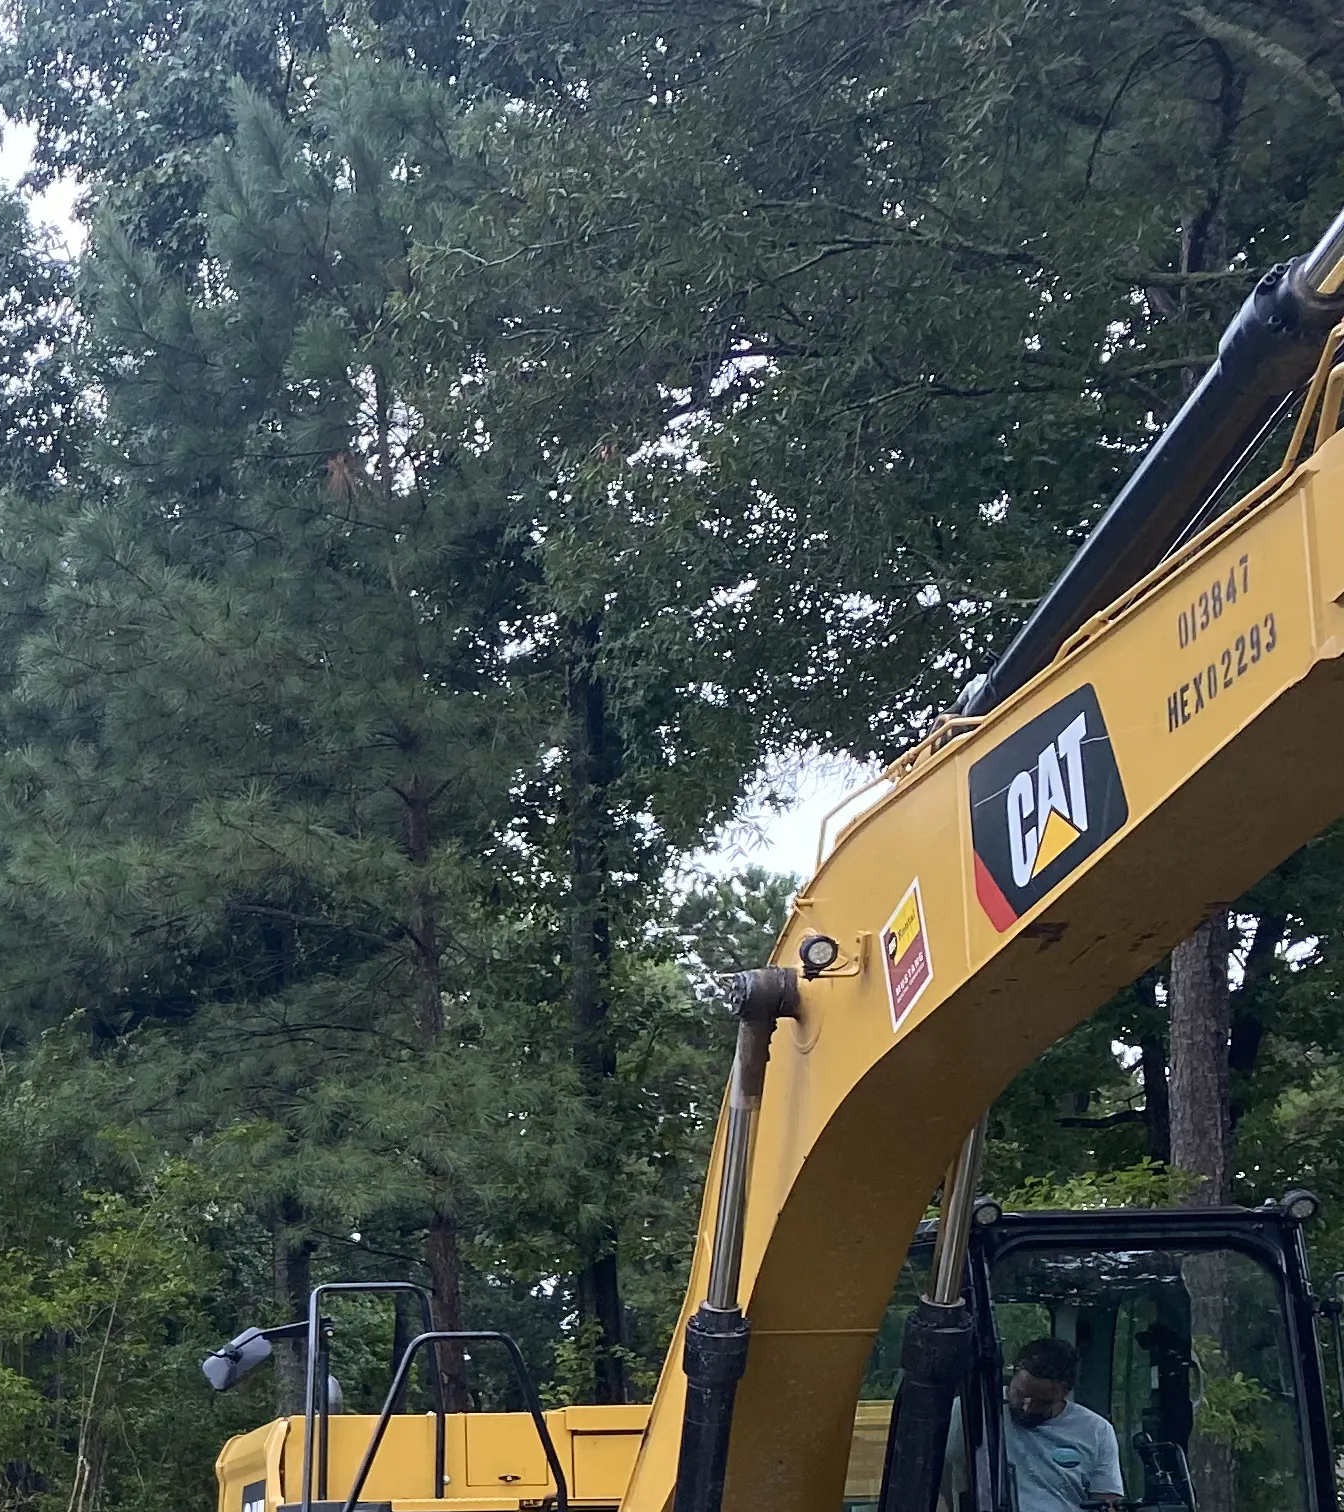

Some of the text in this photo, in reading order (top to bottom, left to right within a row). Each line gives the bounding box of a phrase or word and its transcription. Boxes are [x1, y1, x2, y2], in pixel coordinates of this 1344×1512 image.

[1178, 554, 1249, 649] 013847
[1167, 612, 1277, 733] HEX02293
[1007, 711, 1088, 887] CAT
[895, 951, 924, 997] MUSTANG
